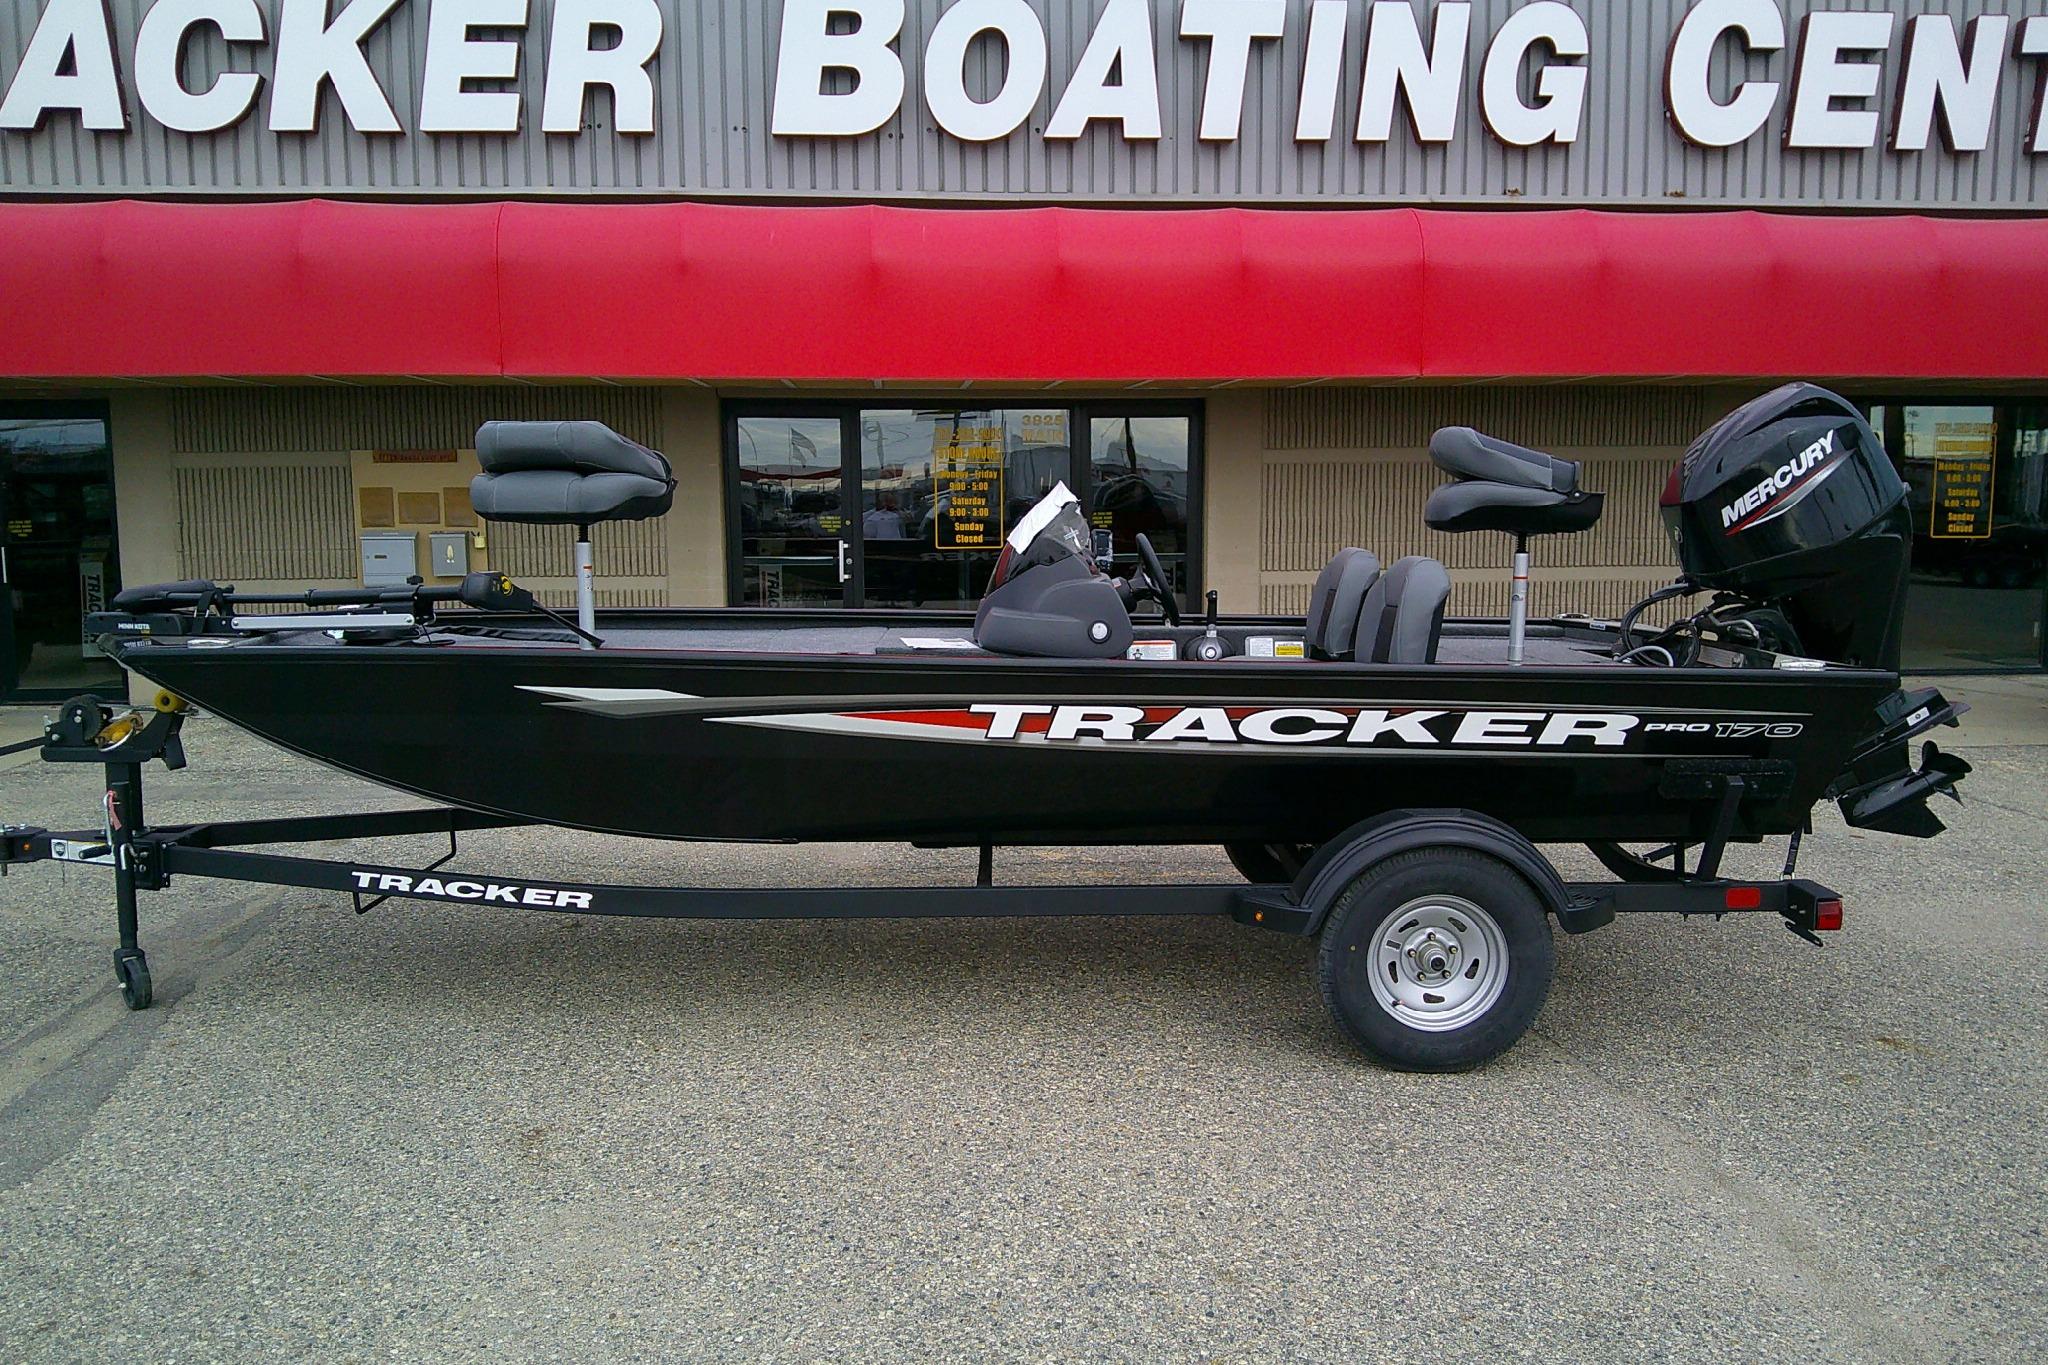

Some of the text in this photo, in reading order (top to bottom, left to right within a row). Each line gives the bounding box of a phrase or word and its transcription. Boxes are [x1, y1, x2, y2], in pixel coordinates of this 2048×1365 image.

[0, 0, 663, 134] ACKER
[772, 0, 1589, 146] BOATING
[1022, 414, 1065, 426] 3825
[1023, 427, 1065, 442] MAIN
[940, 470, 968, 479] Monday
[975, 470, 998, 480] Friday
[1721, 429, 1834, 528] MERCURY
[949, 482, 966, 491] 9:00
[972, 482, 988, 491] 5:00
[952, 496, 986, 506] Saturday
[949, 508, 966, 517] 9:00
[972, 508, 989, 517] 3:00
[1948, 512, 1975, 522] Sunday
[954, 522, 984, 532] Sunday
[1948, 524, 1974, 533] Closed
[955, 534, 984, 543] Closed
[970, 704, 1804, 745] TRACKER PRO 170
[351, 871, 594, 909] TRACKER
